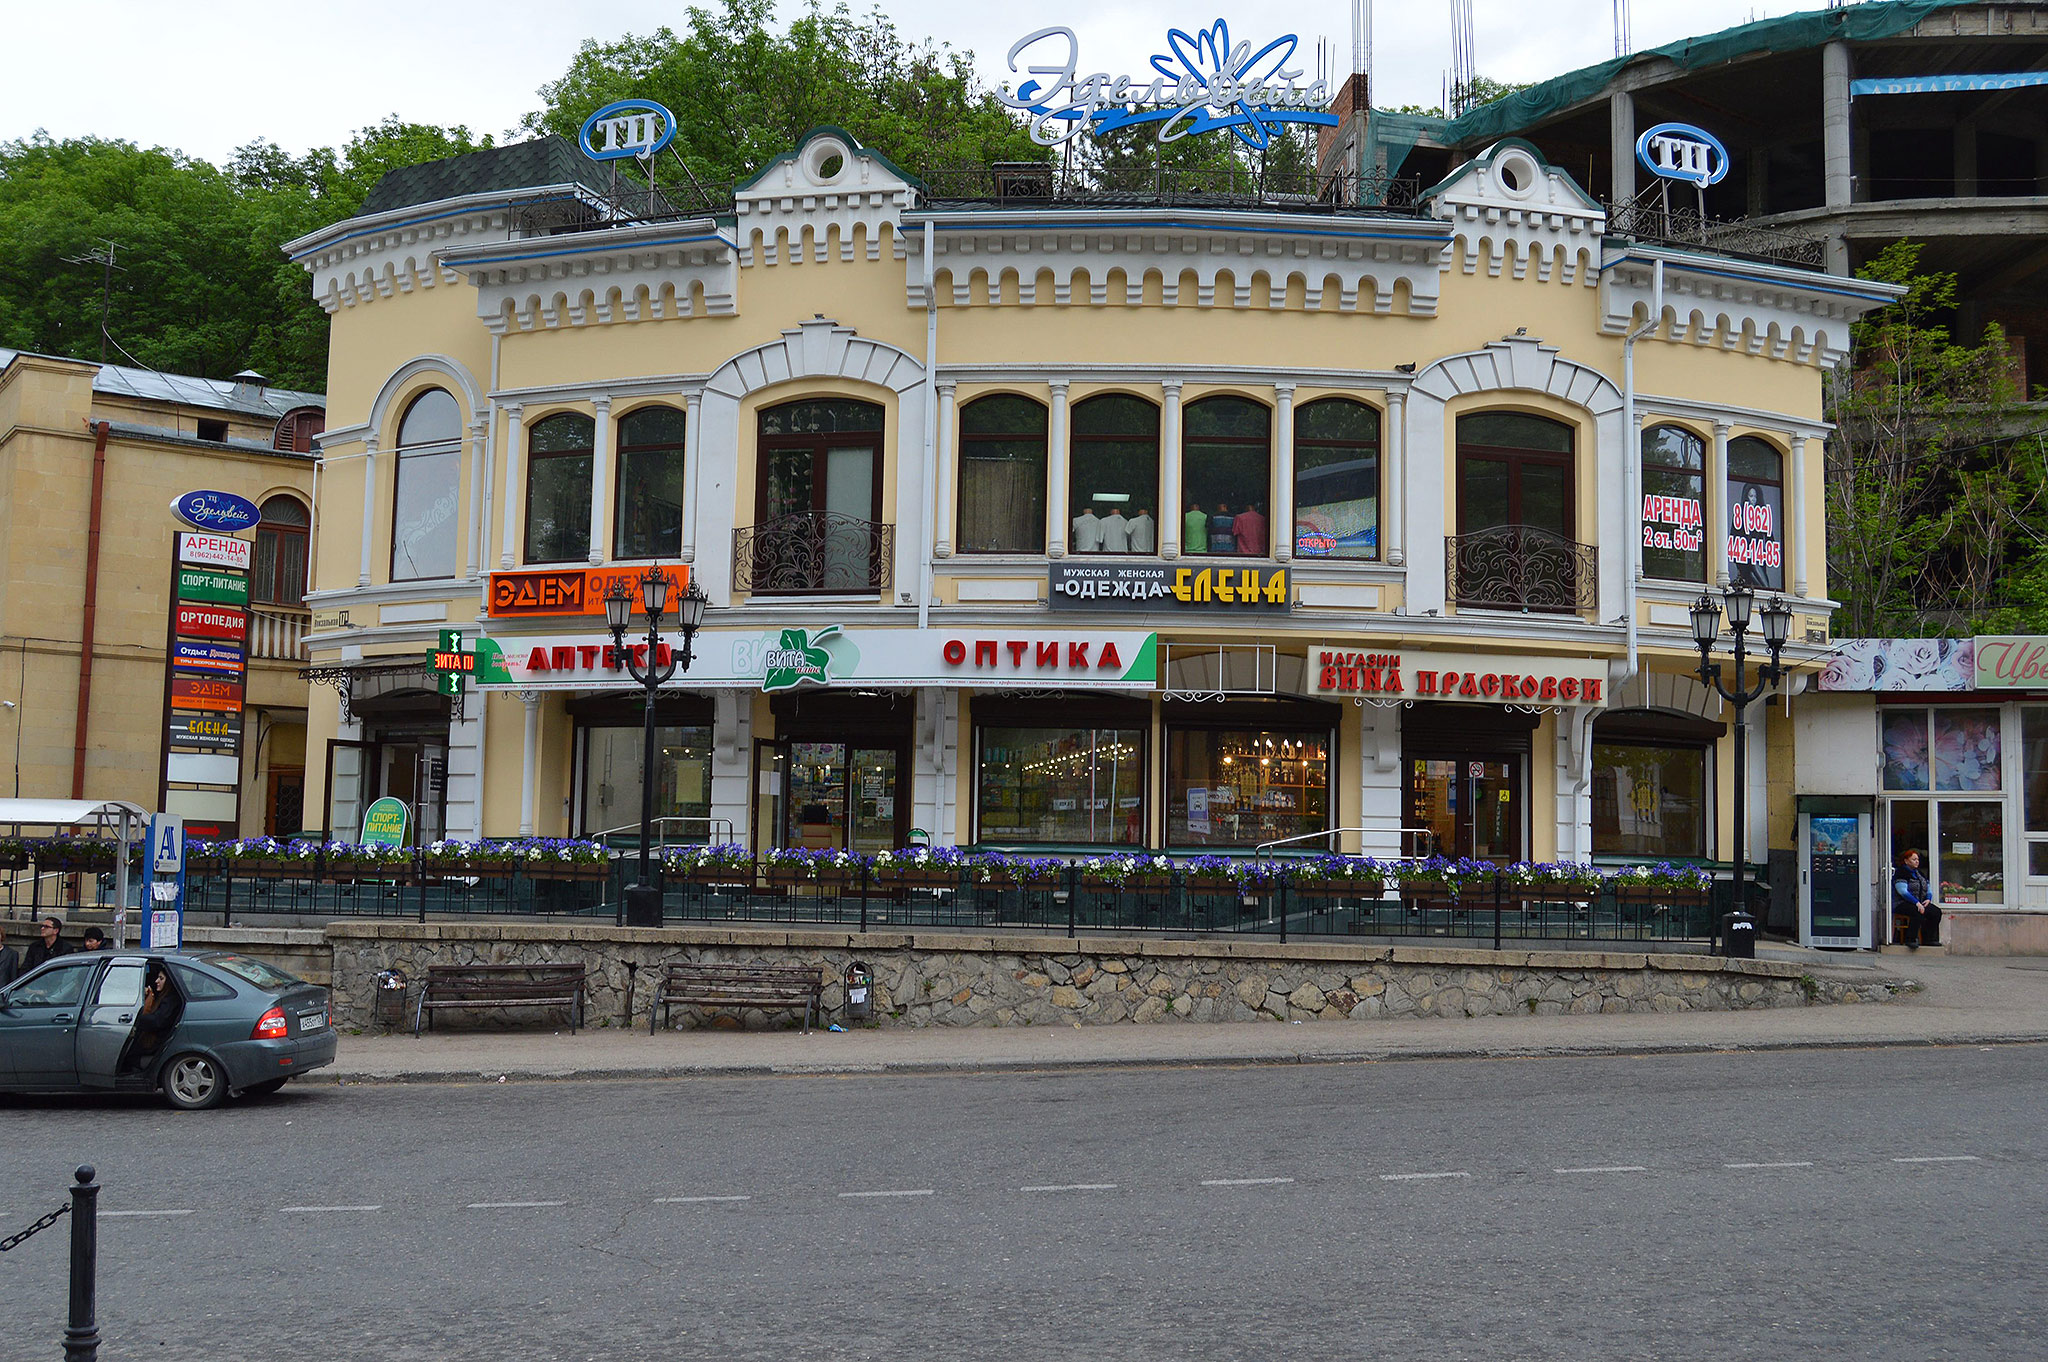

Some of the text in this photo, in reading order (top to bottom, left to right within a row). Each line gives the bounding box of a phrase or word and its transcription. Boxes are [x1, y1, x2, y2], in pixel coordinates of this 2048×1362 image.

[996, 26, 1335, 146] Эдельвейс
[597, 112, 657, 159] ТЦ
[1652, 135, 1711, 189] ТЦ
[1643, 494, 1702, 530] АРЕНДА
[1734, 501, 1772, 537] 8 (962)
[186, 536, 247, 556] АРЕНДА
[1298, 537, 1337, 549] ОТКРЫТО
[1643, 526, 1653, 547] 2
[1654, 531, 1672, 549] эт.
[1728, 535, 1780, 568] 442-14-85
[181, 574, 246, 592] СПОРТ-ПИТАНИЕ
[1063, 568, 1164, 578] МУЖСКАЯ ЖЕНСКАЯ
[495, 578, 581, 607] ЭДЕМ
[1064, 579, 1164, 600] ОДЕЖДА
[1170, 567, 1287, 604] ЕЛЕНА
[180, 611, 244, 629] ОРТОПЕДИЯ
[180, 646, 207, 656] Отдых
[766, 650, 806, 668] ВИТА
[943, 639, 1123, 668] ОПТИКА
[1320, 651, 1401, 667] МАГАЗИН
[190, 681, 231, 697] ЭДЕМ
[1318, 666, 1405, 692] ВИНА
[188, 720, 229, 736] ЕЛЕНА
[366, 822, 403, 833] ПИТАНИЕ
[372, 812, 400, 823] СПОРТ-
